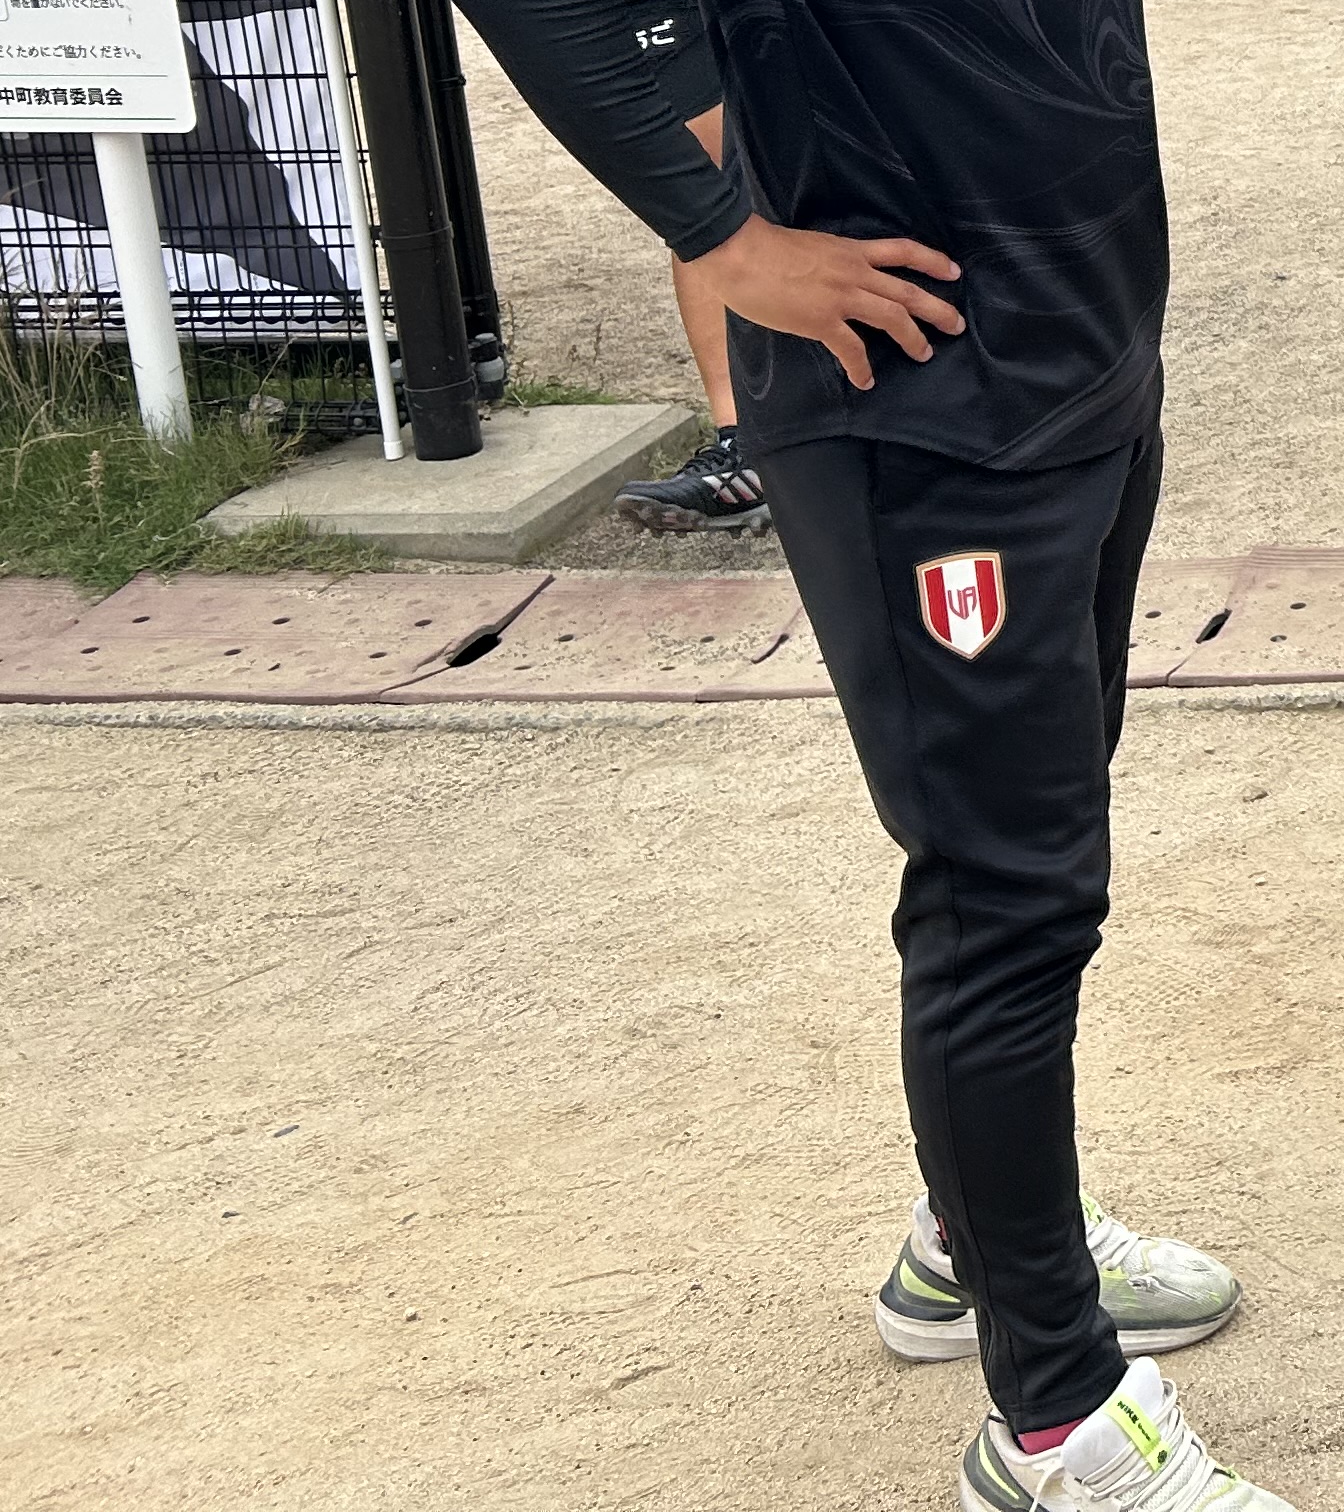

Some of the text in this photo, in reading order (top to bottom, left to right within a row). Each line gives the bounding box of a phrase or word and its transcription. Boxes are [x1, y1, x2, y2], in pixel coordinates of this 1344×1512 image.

[0, 87, 123, 106] 中町教育委員会
